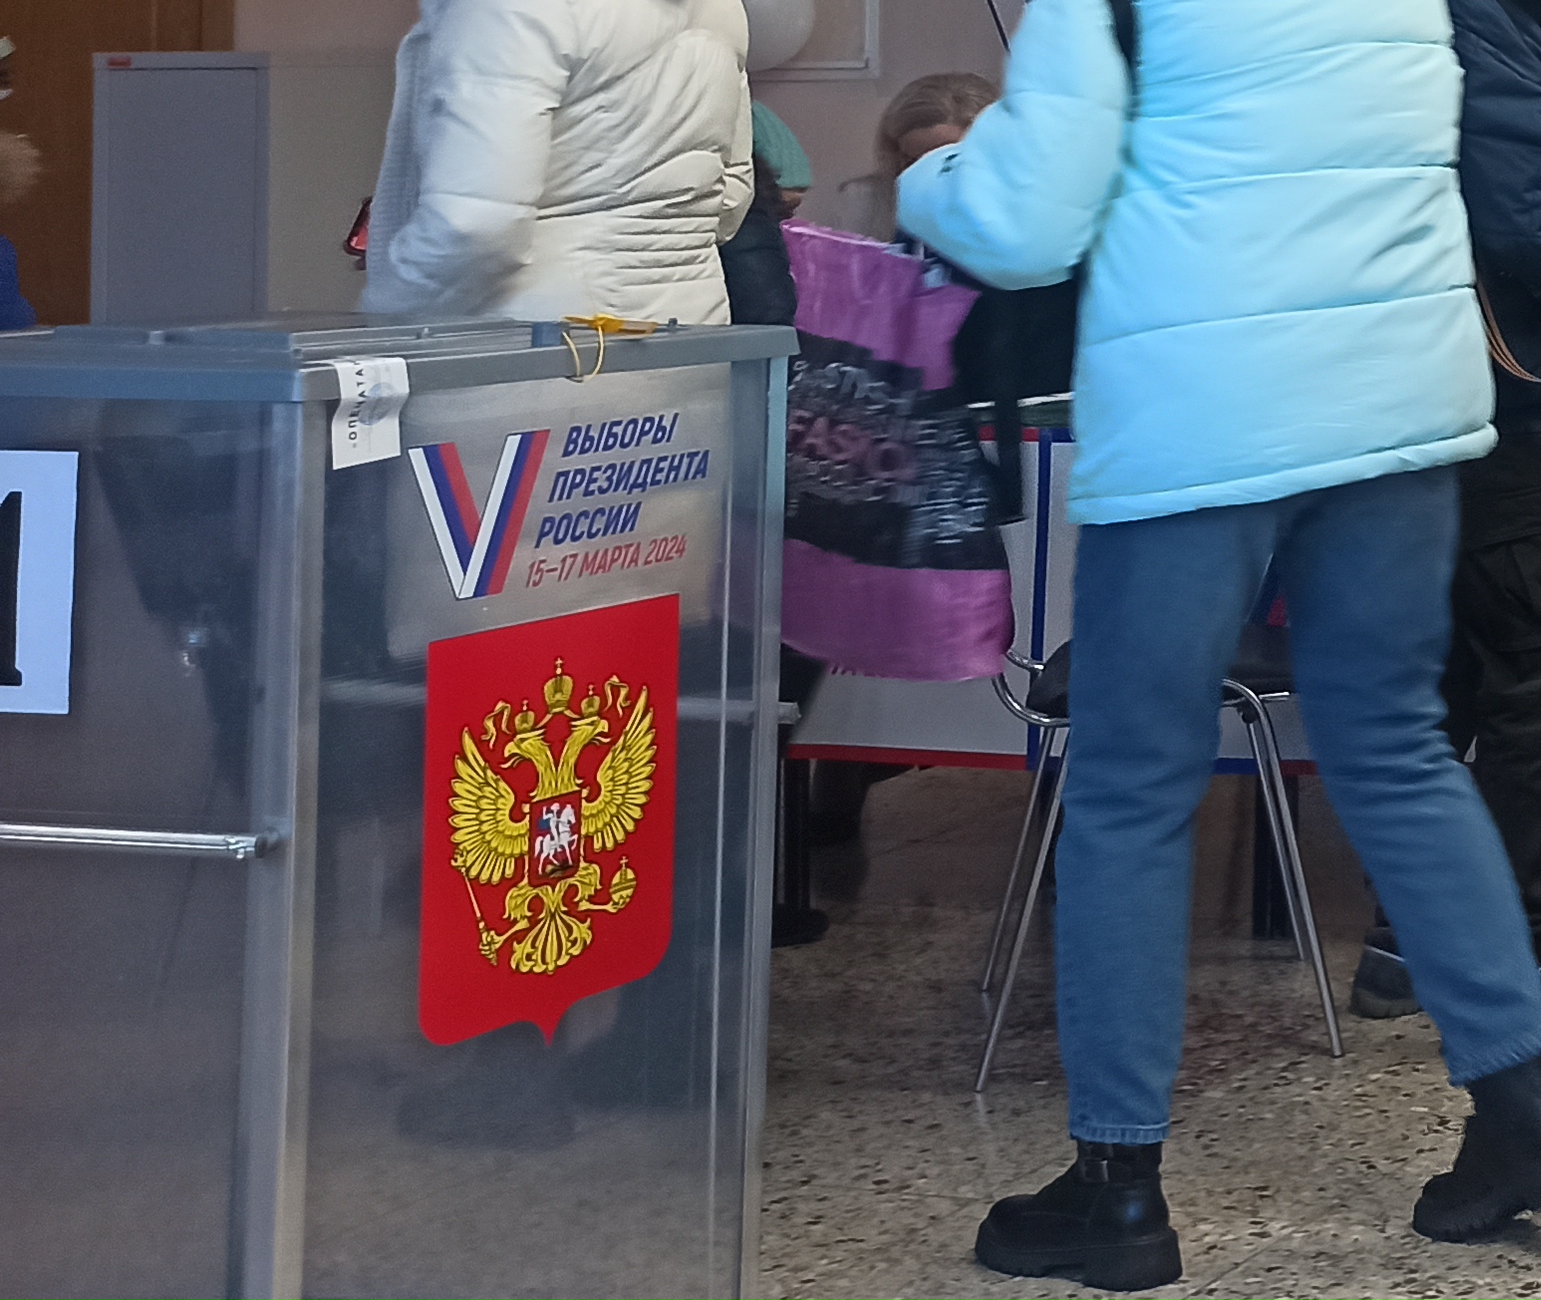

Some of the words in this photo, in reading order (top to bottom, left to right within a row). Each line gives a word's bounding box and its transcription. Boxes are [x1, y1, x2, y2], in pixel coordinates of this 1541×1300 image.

[562, 413, 679, 458] ВЫБОРЫ
[548, 450, 710, 503] ПРЕЗИДЕНТА
[534, 501, 642, 549] РОССИИ
[578, 543, 641, 578] МАРТА
[644, 534, 687, 565] 2024
